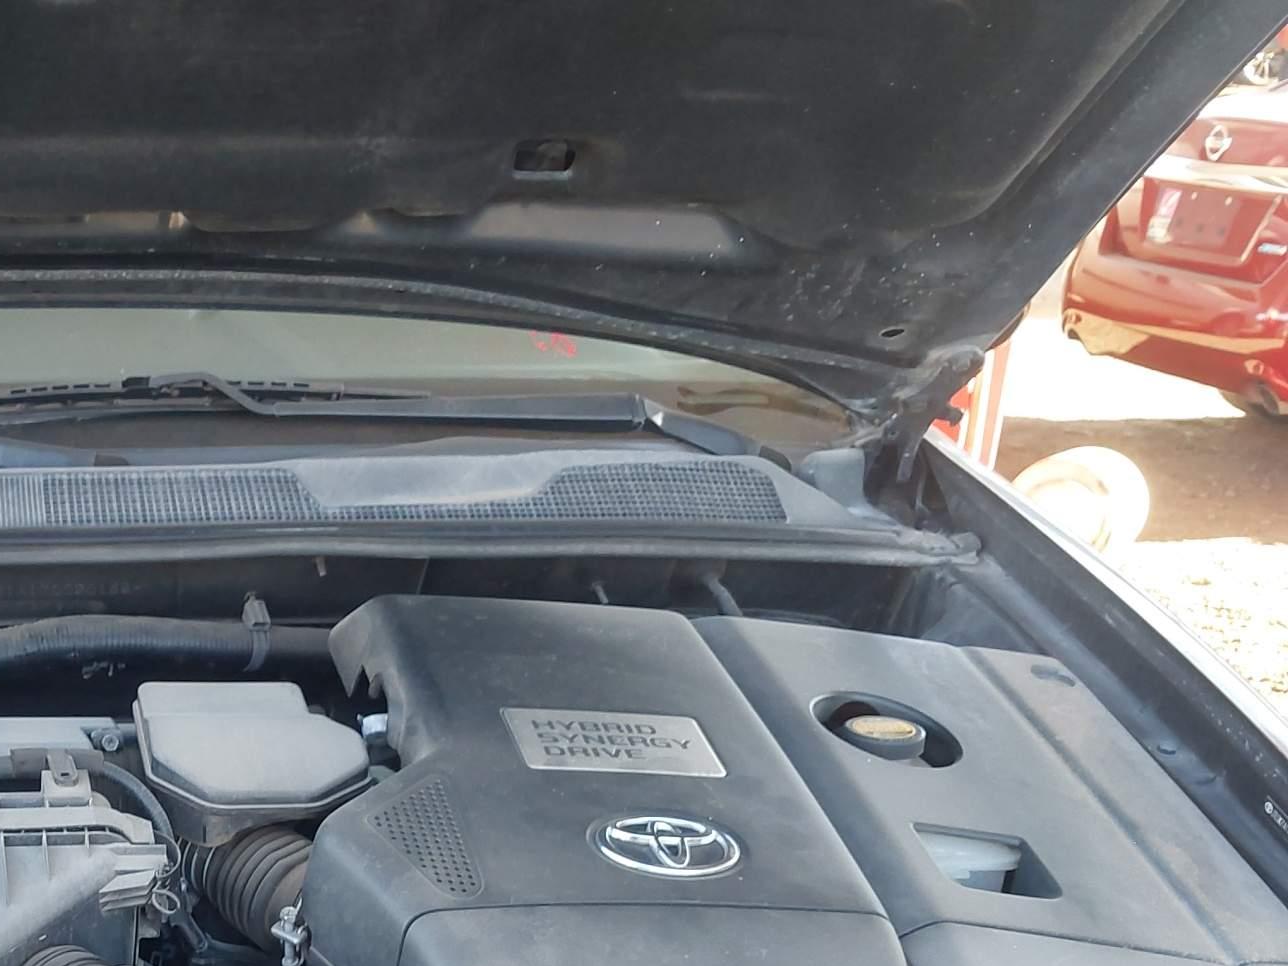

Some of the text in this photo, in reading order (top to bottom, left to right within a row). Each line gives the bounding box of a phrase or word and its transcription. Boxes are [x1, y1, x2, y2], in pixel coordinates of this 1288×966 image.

[531, 720, 657, 735] HYBRID
[537, 732, 691, 750] SYNERGY
[544, 746, 648, 760] DRIVE
